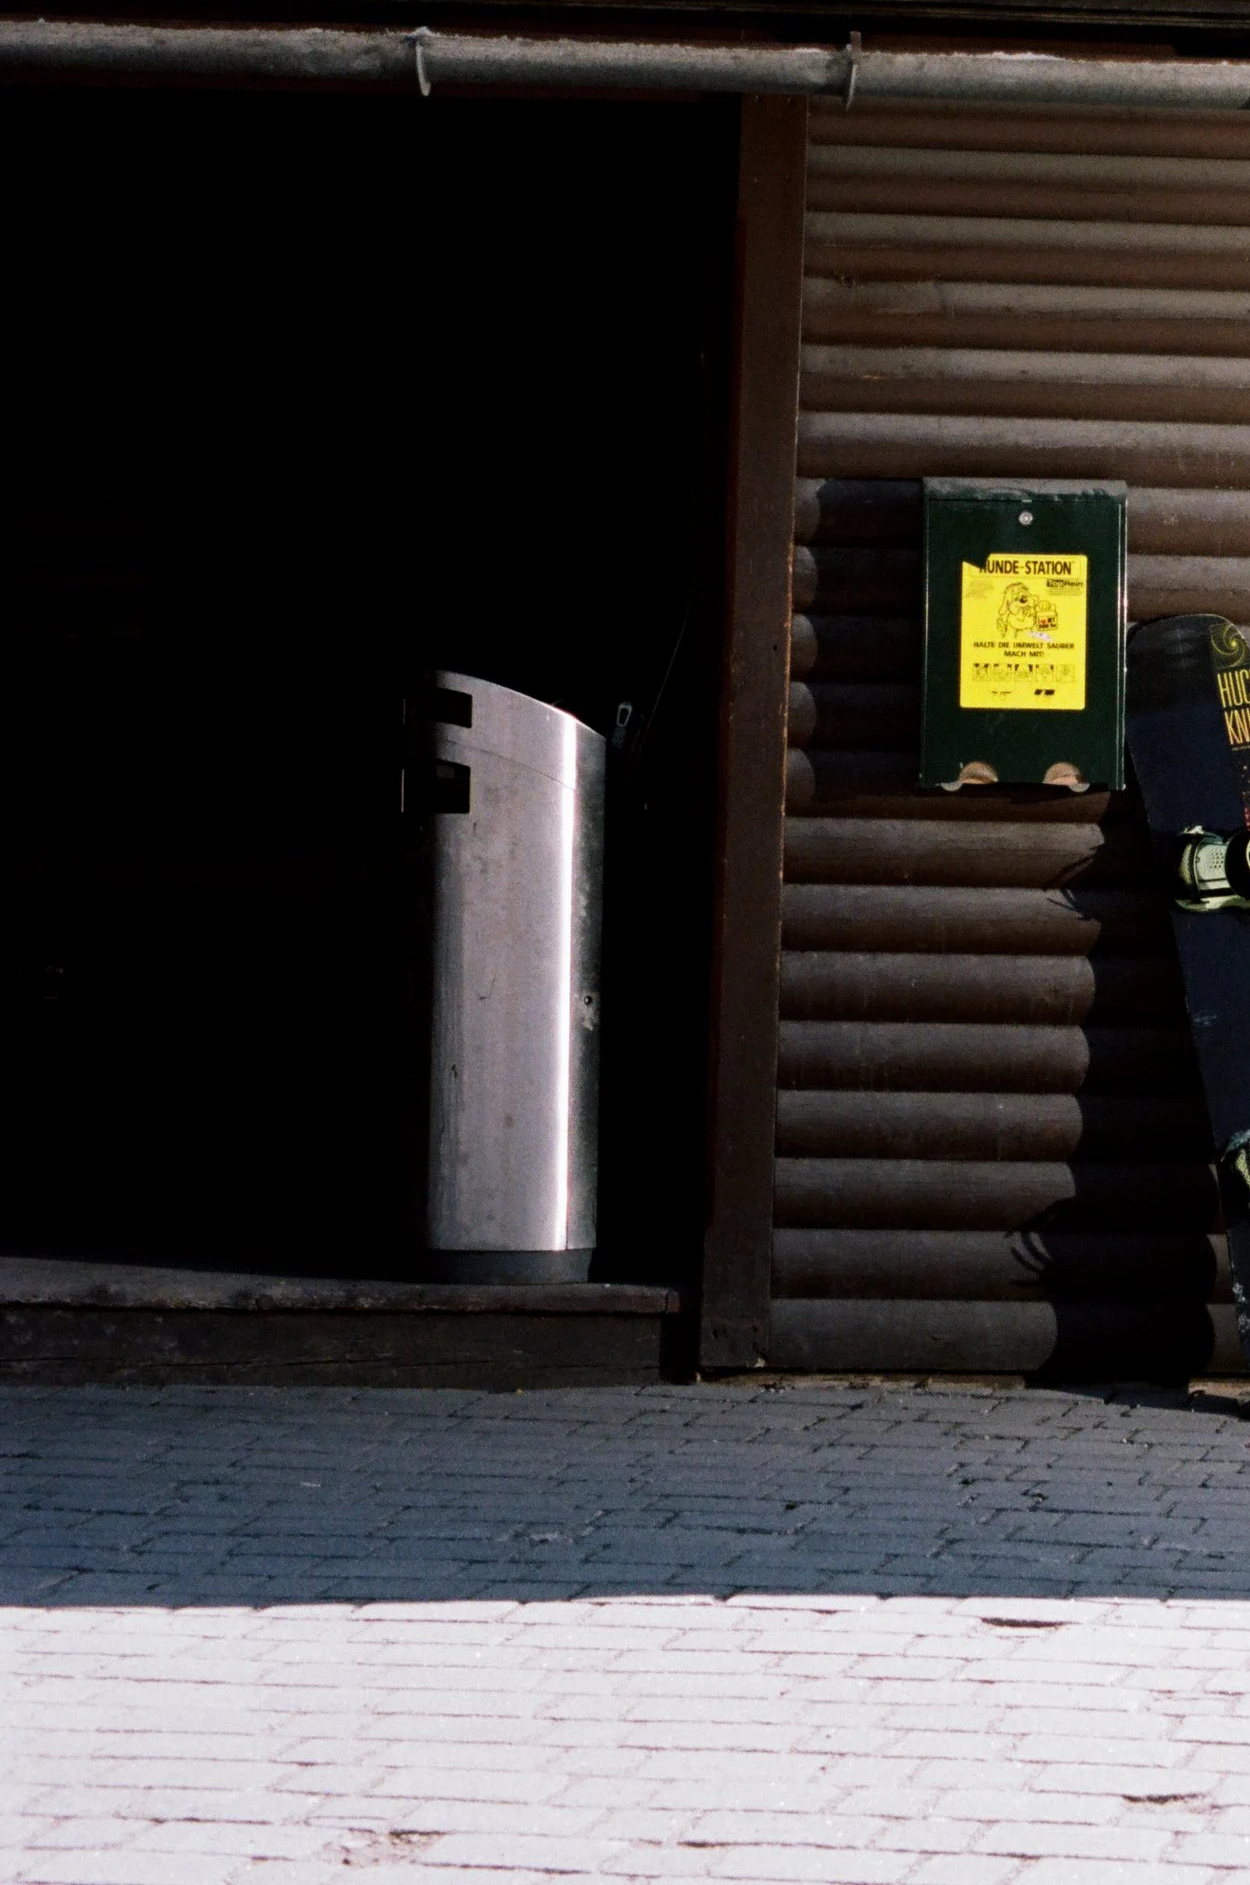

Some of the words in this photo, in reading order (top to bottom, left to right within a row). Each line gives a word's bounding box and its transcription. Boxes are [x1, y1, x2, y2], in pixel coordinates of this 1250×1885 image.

[973, 641, 995, 649] HALTE
[998, 641, 1010, 649] DIE
[1047, 642, 1075, 650] SAUBER
[1003, 650, 1027, 658] MACH
